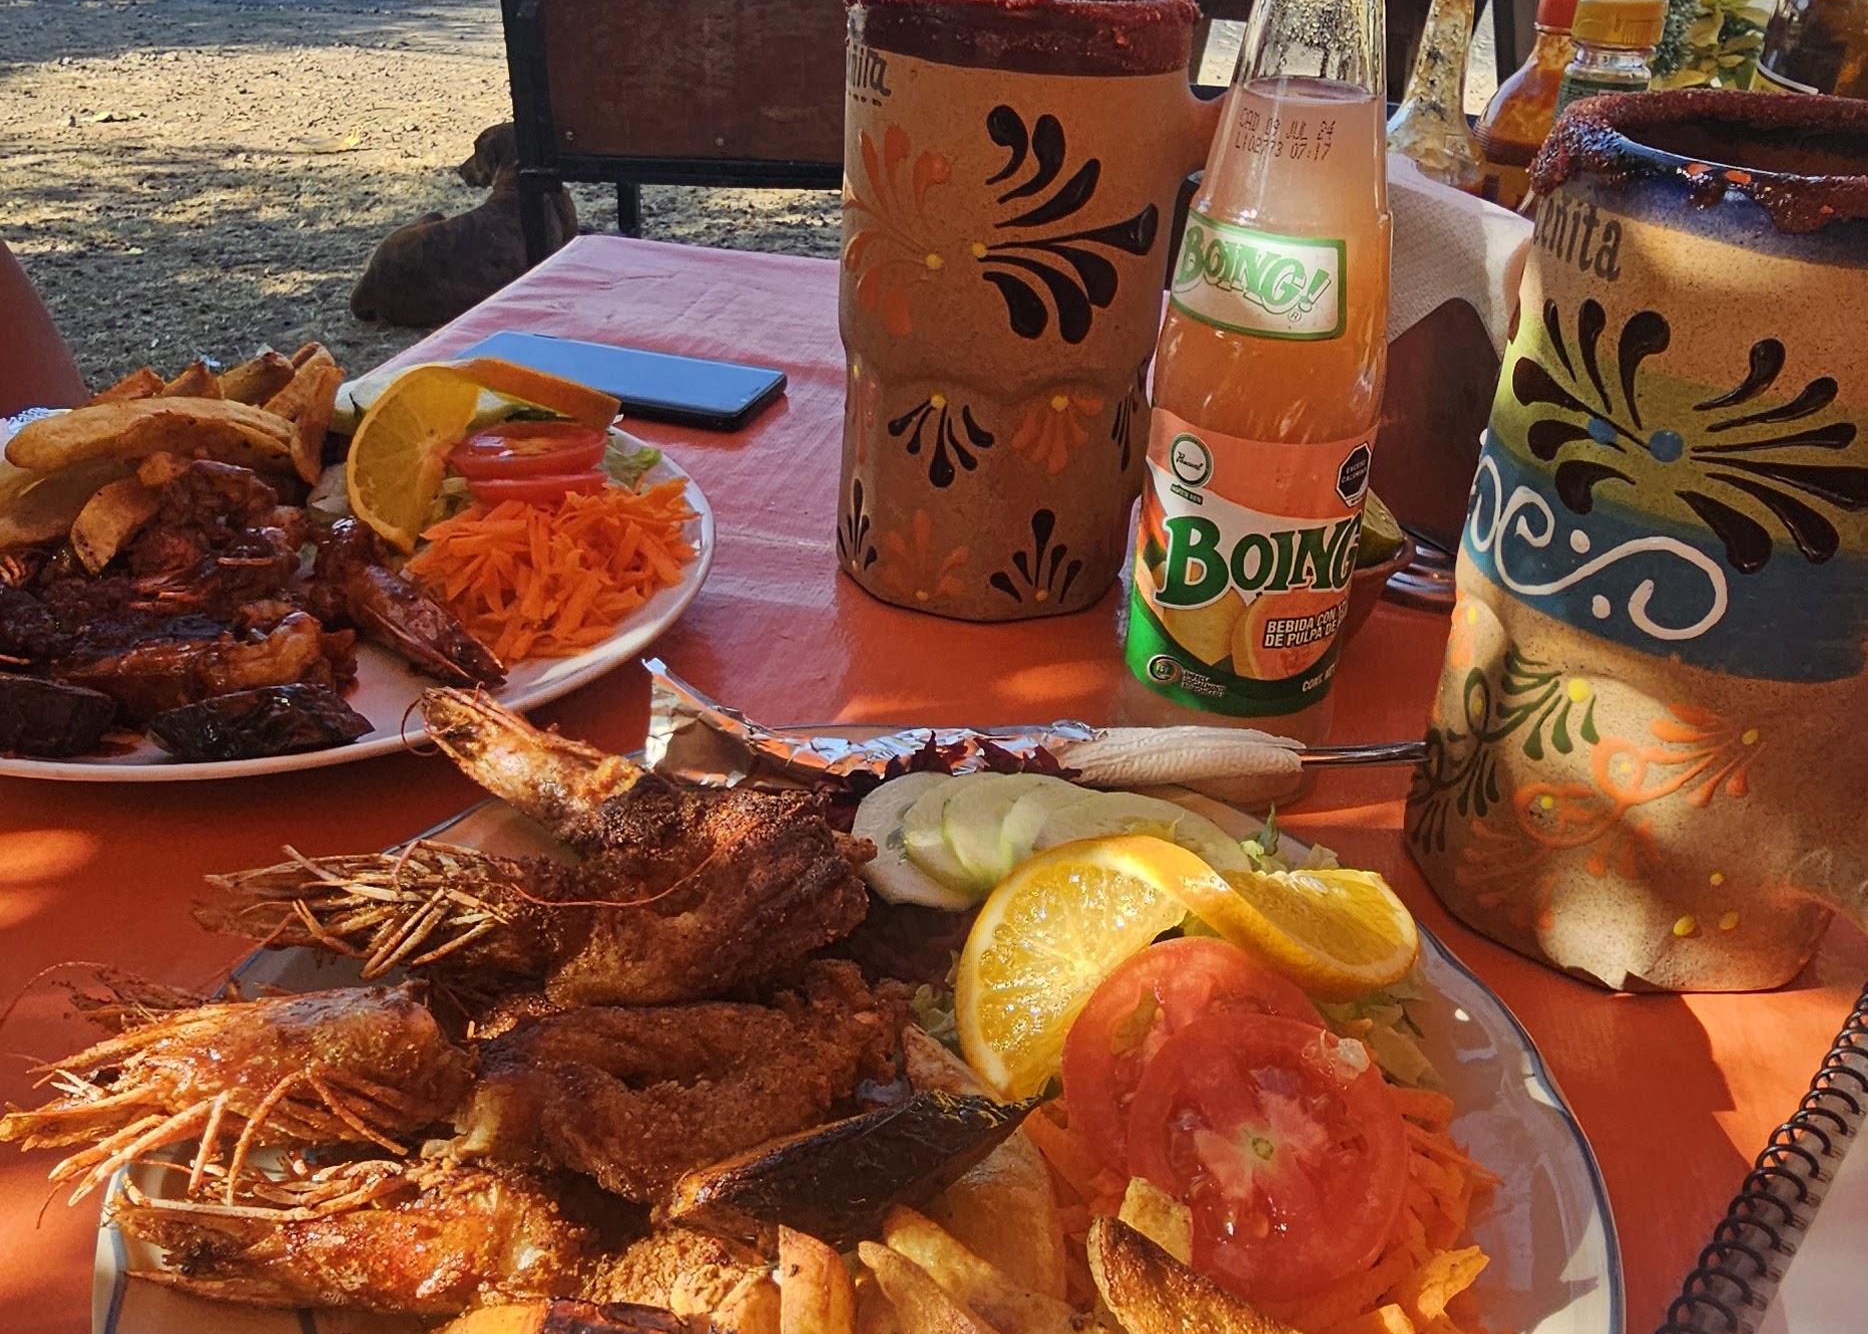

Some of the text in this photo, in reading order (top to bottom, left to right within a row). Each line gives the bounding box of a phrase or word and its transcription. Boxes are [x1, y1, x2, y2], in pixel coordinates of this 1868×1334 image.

[1239, 107, 1260, 132] CAD
[1285, 120, 1308, 140] JUL
[1316, 120, 1337, 141] 24
[1290, 141, 1333, 161] 07:17
[1172, 225, 1332, 315] BOING!
[1264, 633, 1285, 648] DE
[1286, 625, 1323, 647] PULPA
[1325, 619, 1338, 637] DE
[1266, 616, 1315, 635] BEBIDA
[1316, 607, 1337, 628] CON
